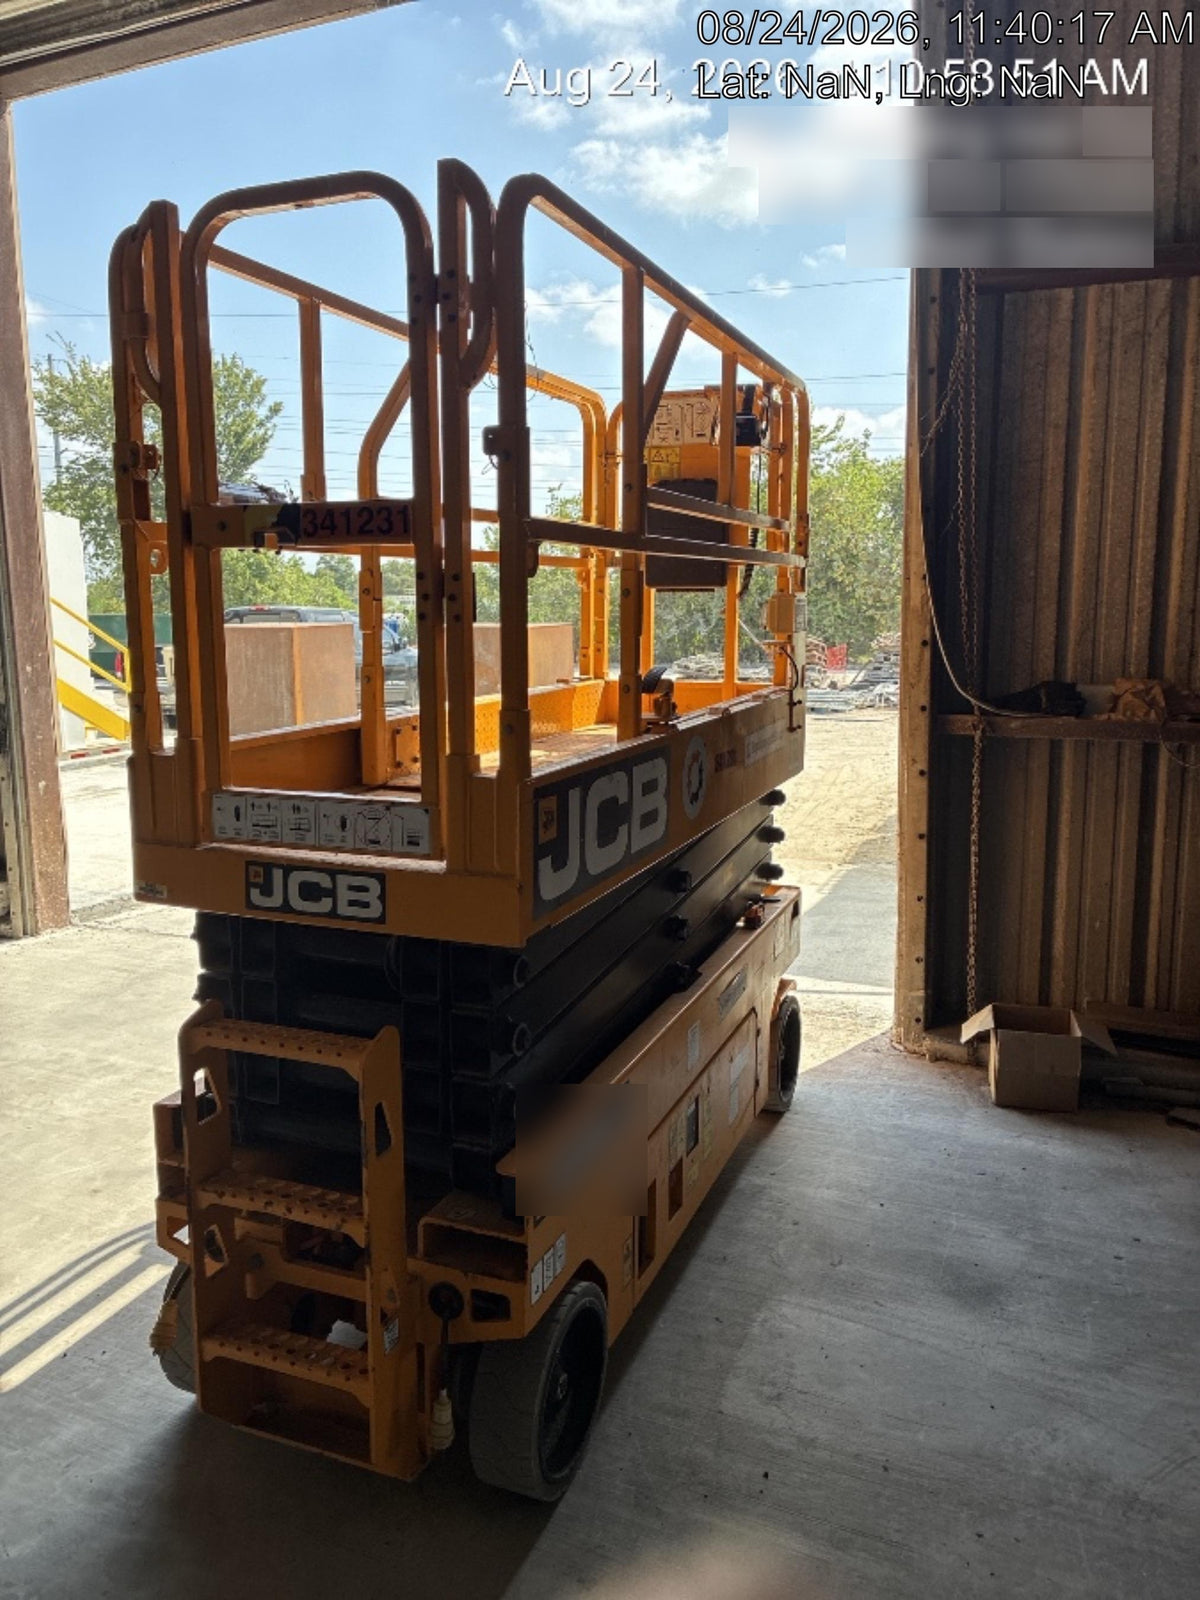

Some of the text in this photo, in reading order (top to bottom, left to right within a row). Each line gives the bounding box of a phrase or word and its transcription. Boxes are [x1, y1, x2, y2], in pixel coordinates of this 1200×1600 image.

[302, 504, 411, 537] 341231
[537, 757, 668, 901] JCB
[249, 866, 384, 919] JCB
